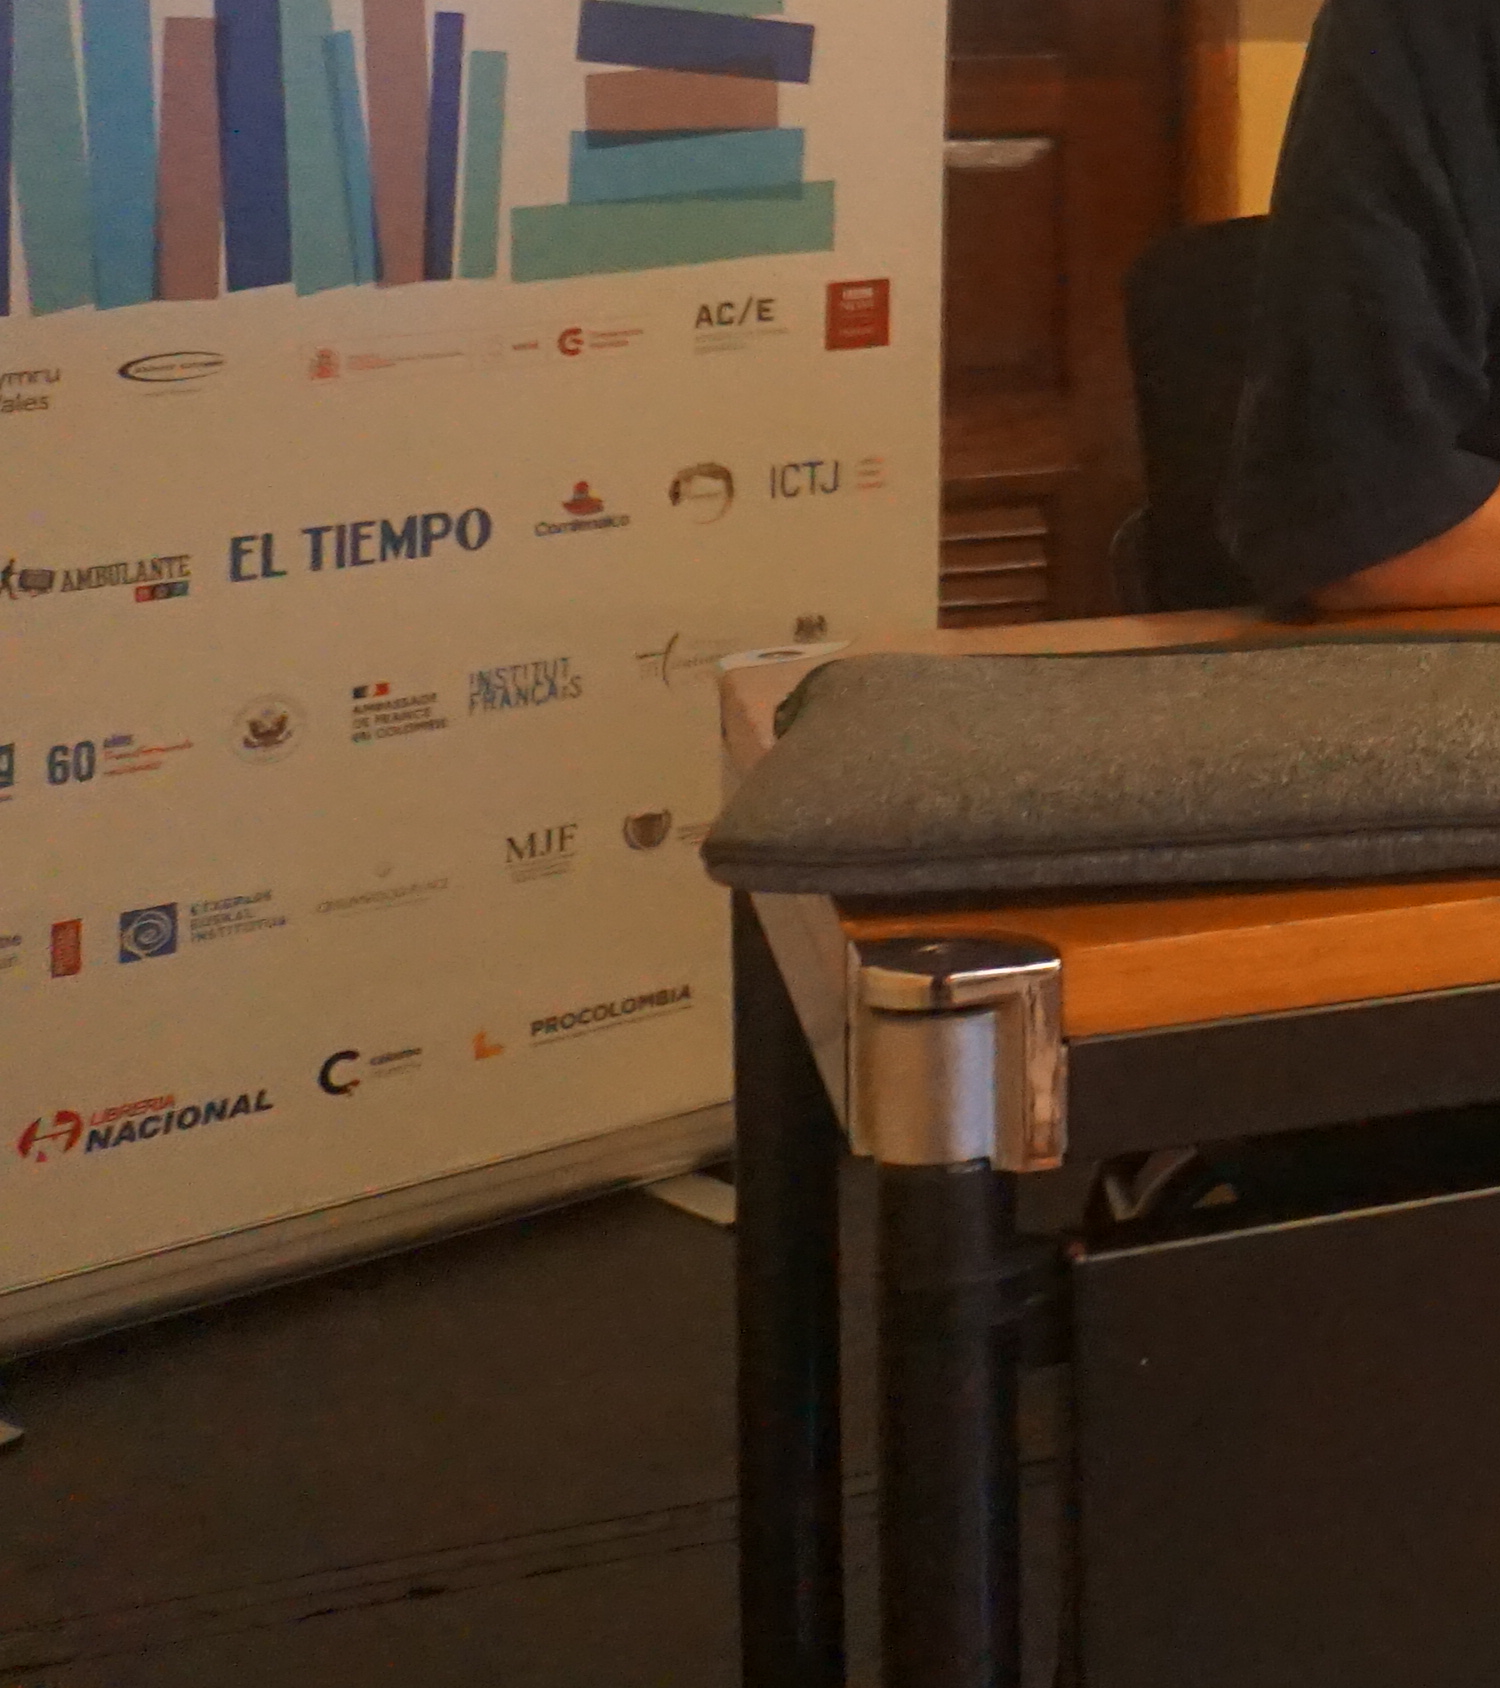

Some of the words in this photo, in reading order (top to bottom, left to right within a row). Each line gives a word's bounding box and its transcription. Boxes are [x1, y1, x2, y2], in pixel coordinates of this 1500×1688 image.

[695, 297, 777, 330] AC/E
[770, 459, 841, 500] ICTJ
[228, 531, 288, 583] EL
[302, 507, 493, 572] TIEMPO
[60, 553, 193, 592] AMBULANTE
[46, 739, 97, 787] 60
[505, 822, 580, 865] MJF
[530, 982, 693, 1038] PROCOLOMBIA
[84, 1088, 275, 1154] NACIONAL
